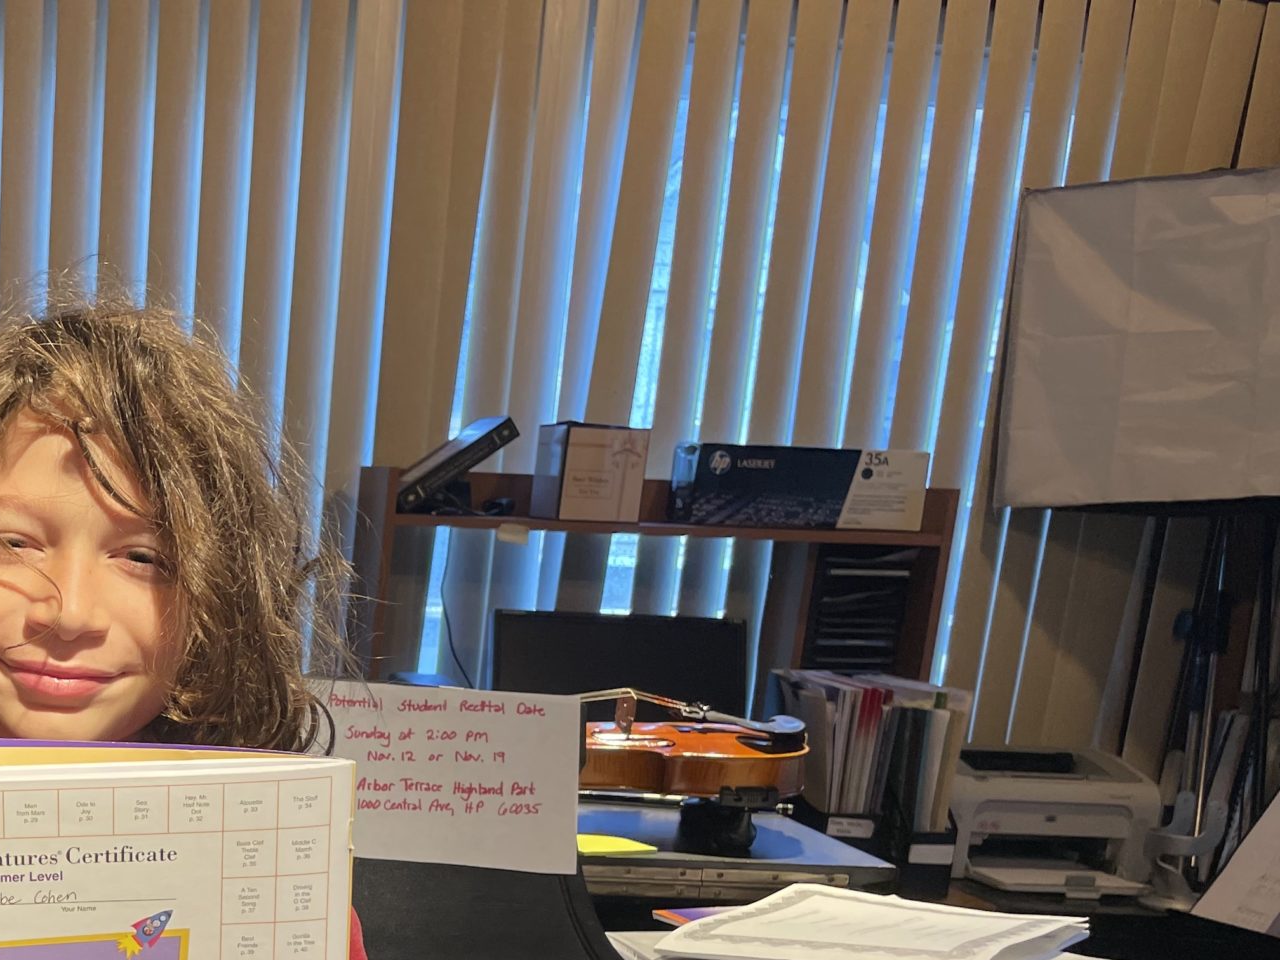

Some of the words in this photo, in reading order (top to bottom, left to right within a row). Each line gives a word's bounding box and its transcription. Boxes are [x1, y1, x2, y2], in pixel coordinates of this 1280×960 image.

[709, 451, 732, 475] hp
[737, 458, 776, 470] LASERJET
[864, 452, 889, 467] 35A
[397, 699, 448, 713] Student
[516, 702, 546, 717] Date
[345, 725, 392, 747] Sunday
[398, 729, 415, 741] at
[426, 729, 457, 741] 2:00
[367, 750, 396, 762] Nov.
[401, 750, 417, 762] 12
[428, 752, 444, 762] or
[455, 751, 484, 763] Nov.
[493, 751, 506, 763] 19
[356, 777, 395, 793] Arbor
[400, 777, 443, 793] Terrace
[453, 777, 504, 800] Highland
[384, 798, 422, 812] Central
[498, 802, 542, 816] 60035
[66, 845, 178, 865] Certificate
[29, 870, 63, 882] Level
[33, 890, 78, 905] Cohen
[78, 904, 97, 912] Name
